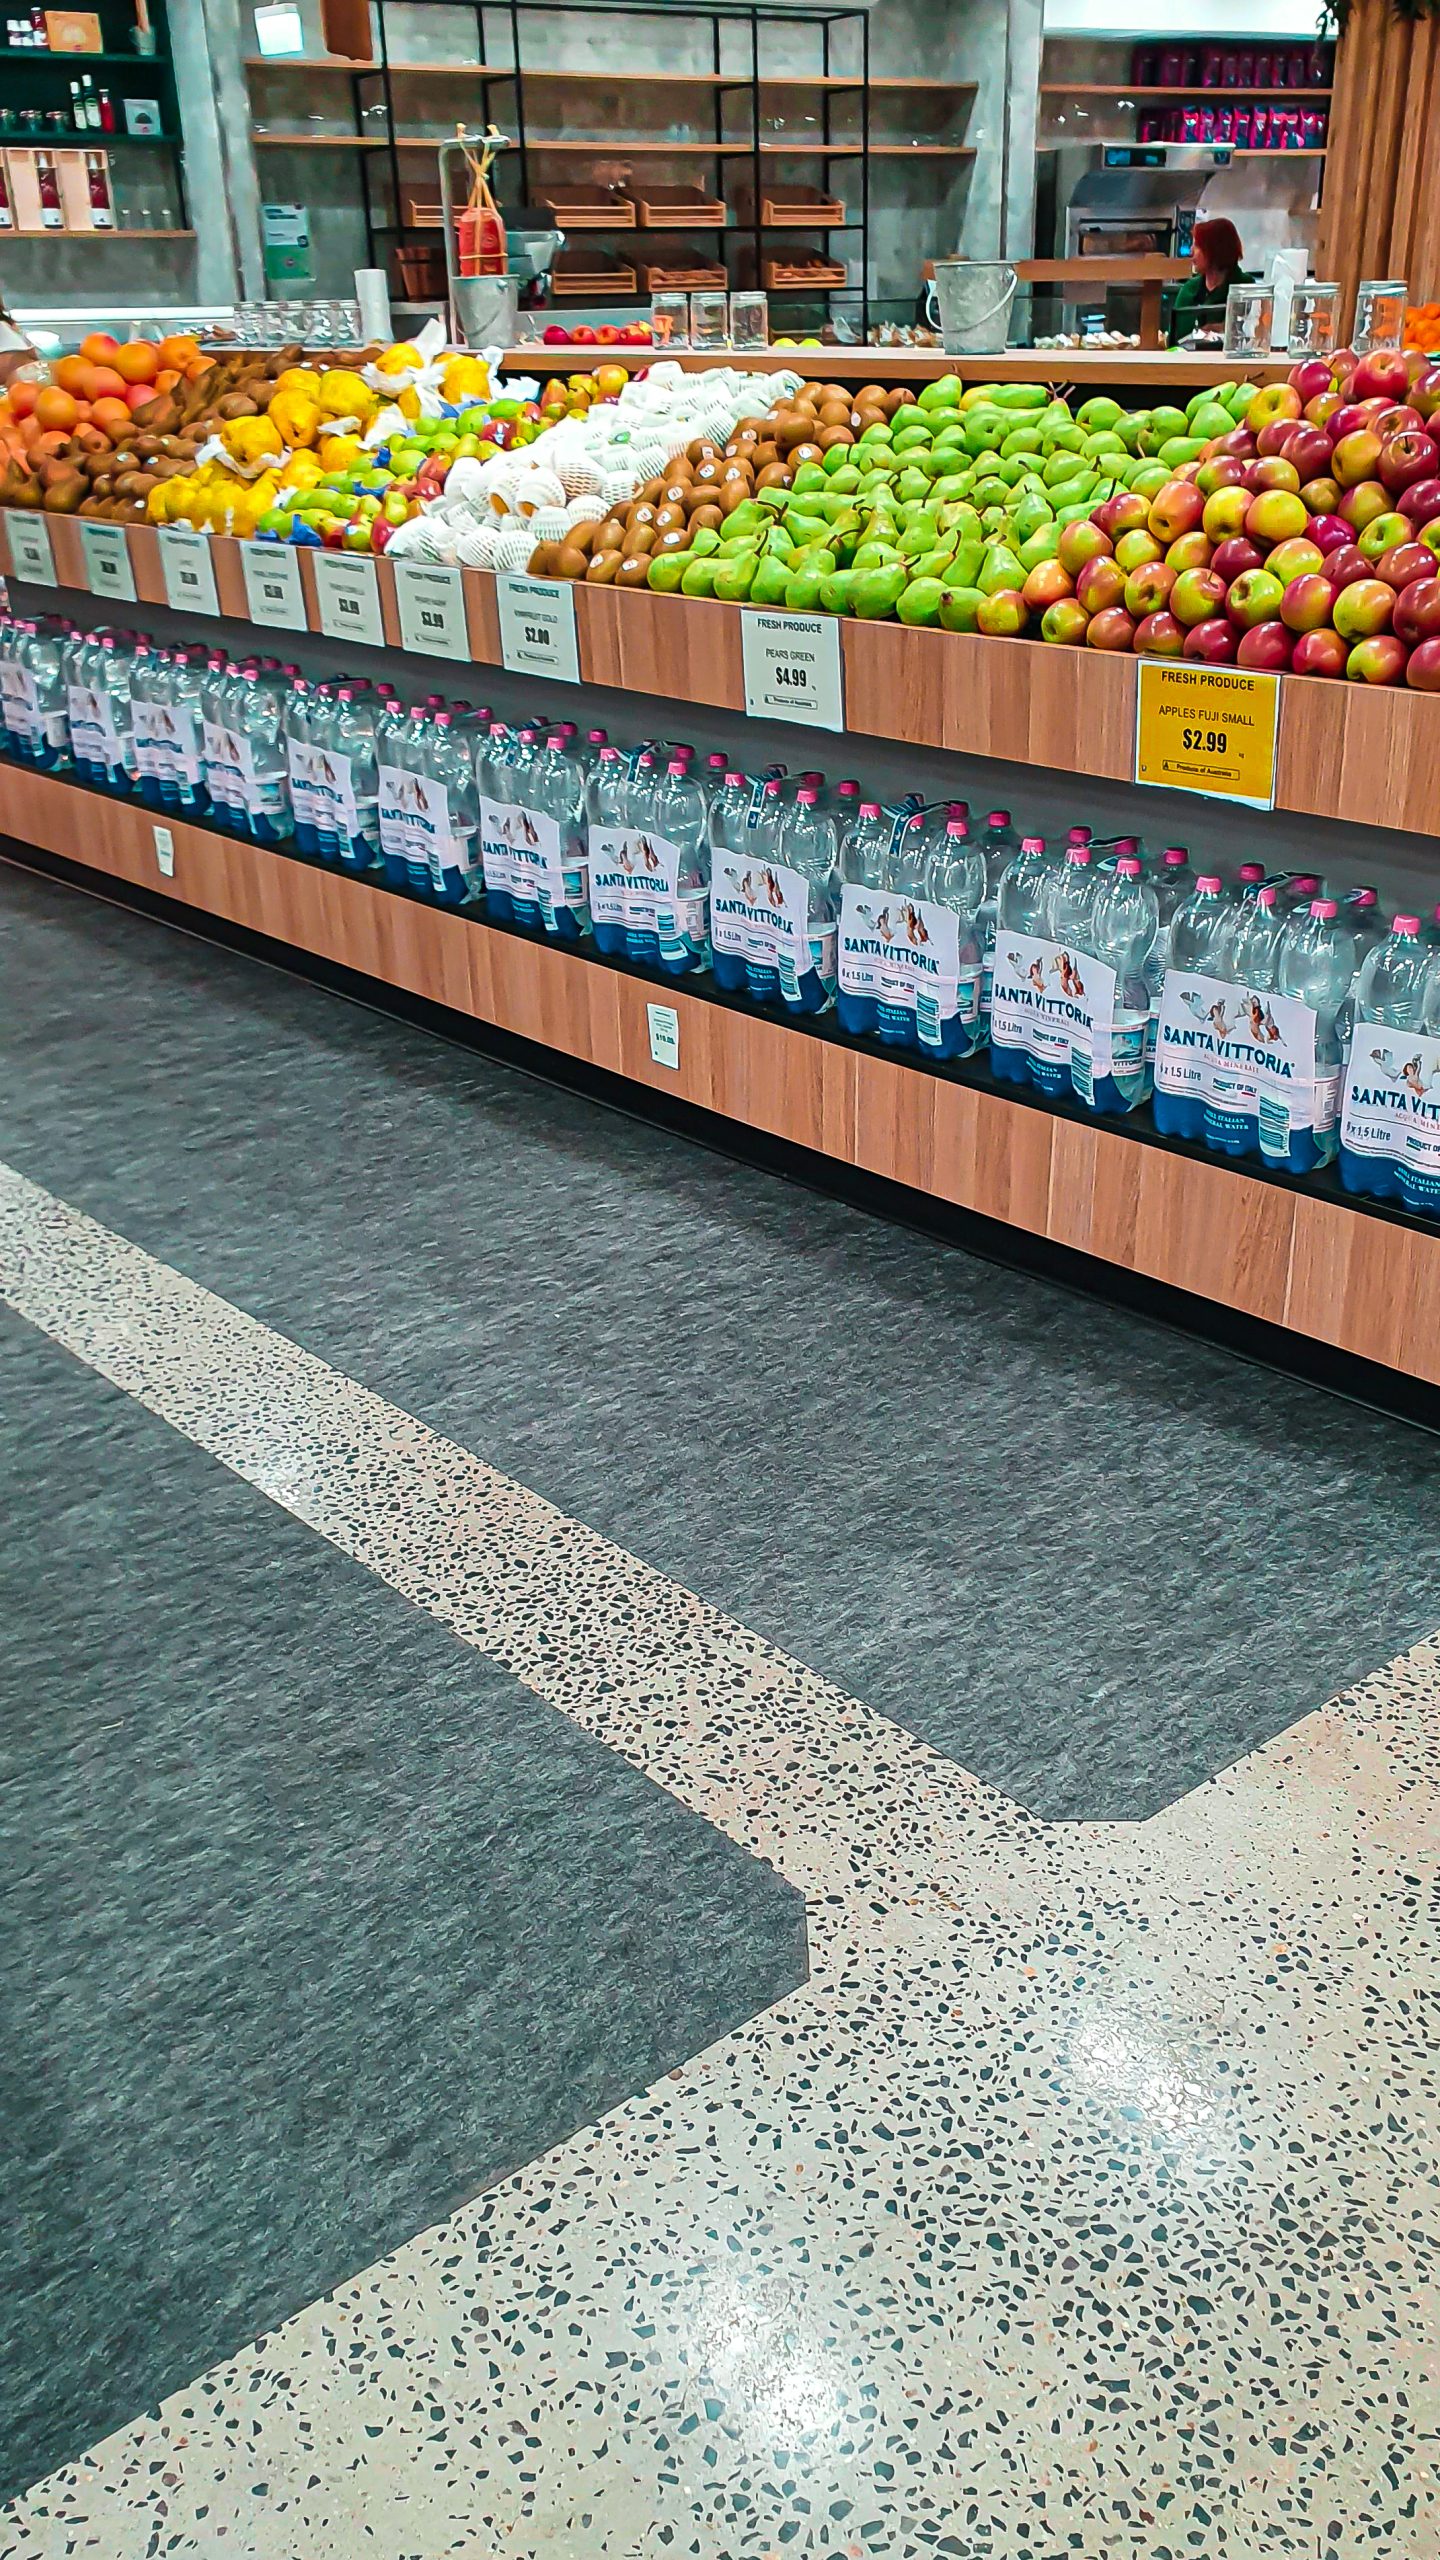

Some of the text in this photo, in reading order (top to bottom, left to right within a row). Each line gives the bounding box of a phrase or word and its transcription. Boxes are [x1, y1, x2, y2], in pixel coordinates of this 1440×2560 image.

[757, 618, 822, 634] FRESH PRODUCE
[766, 648, 815, 662] PEARS GREEN
[775, 666, 807, 687] $4.99
[1161, 671, 1255, 691] FRESH PRODUCE
[1159, 705, 1255, 726] APPLES FUJI SMALL
[1182, 728, 1227, 754] $2.99
[1171, 1066, 1182, 1078] 1.5
[1183, 1068, 1202, 1081] Litre
[1357, 1126, 1370, 1137] 1.5
[1371, 1126, 1391, 1141] Litre
